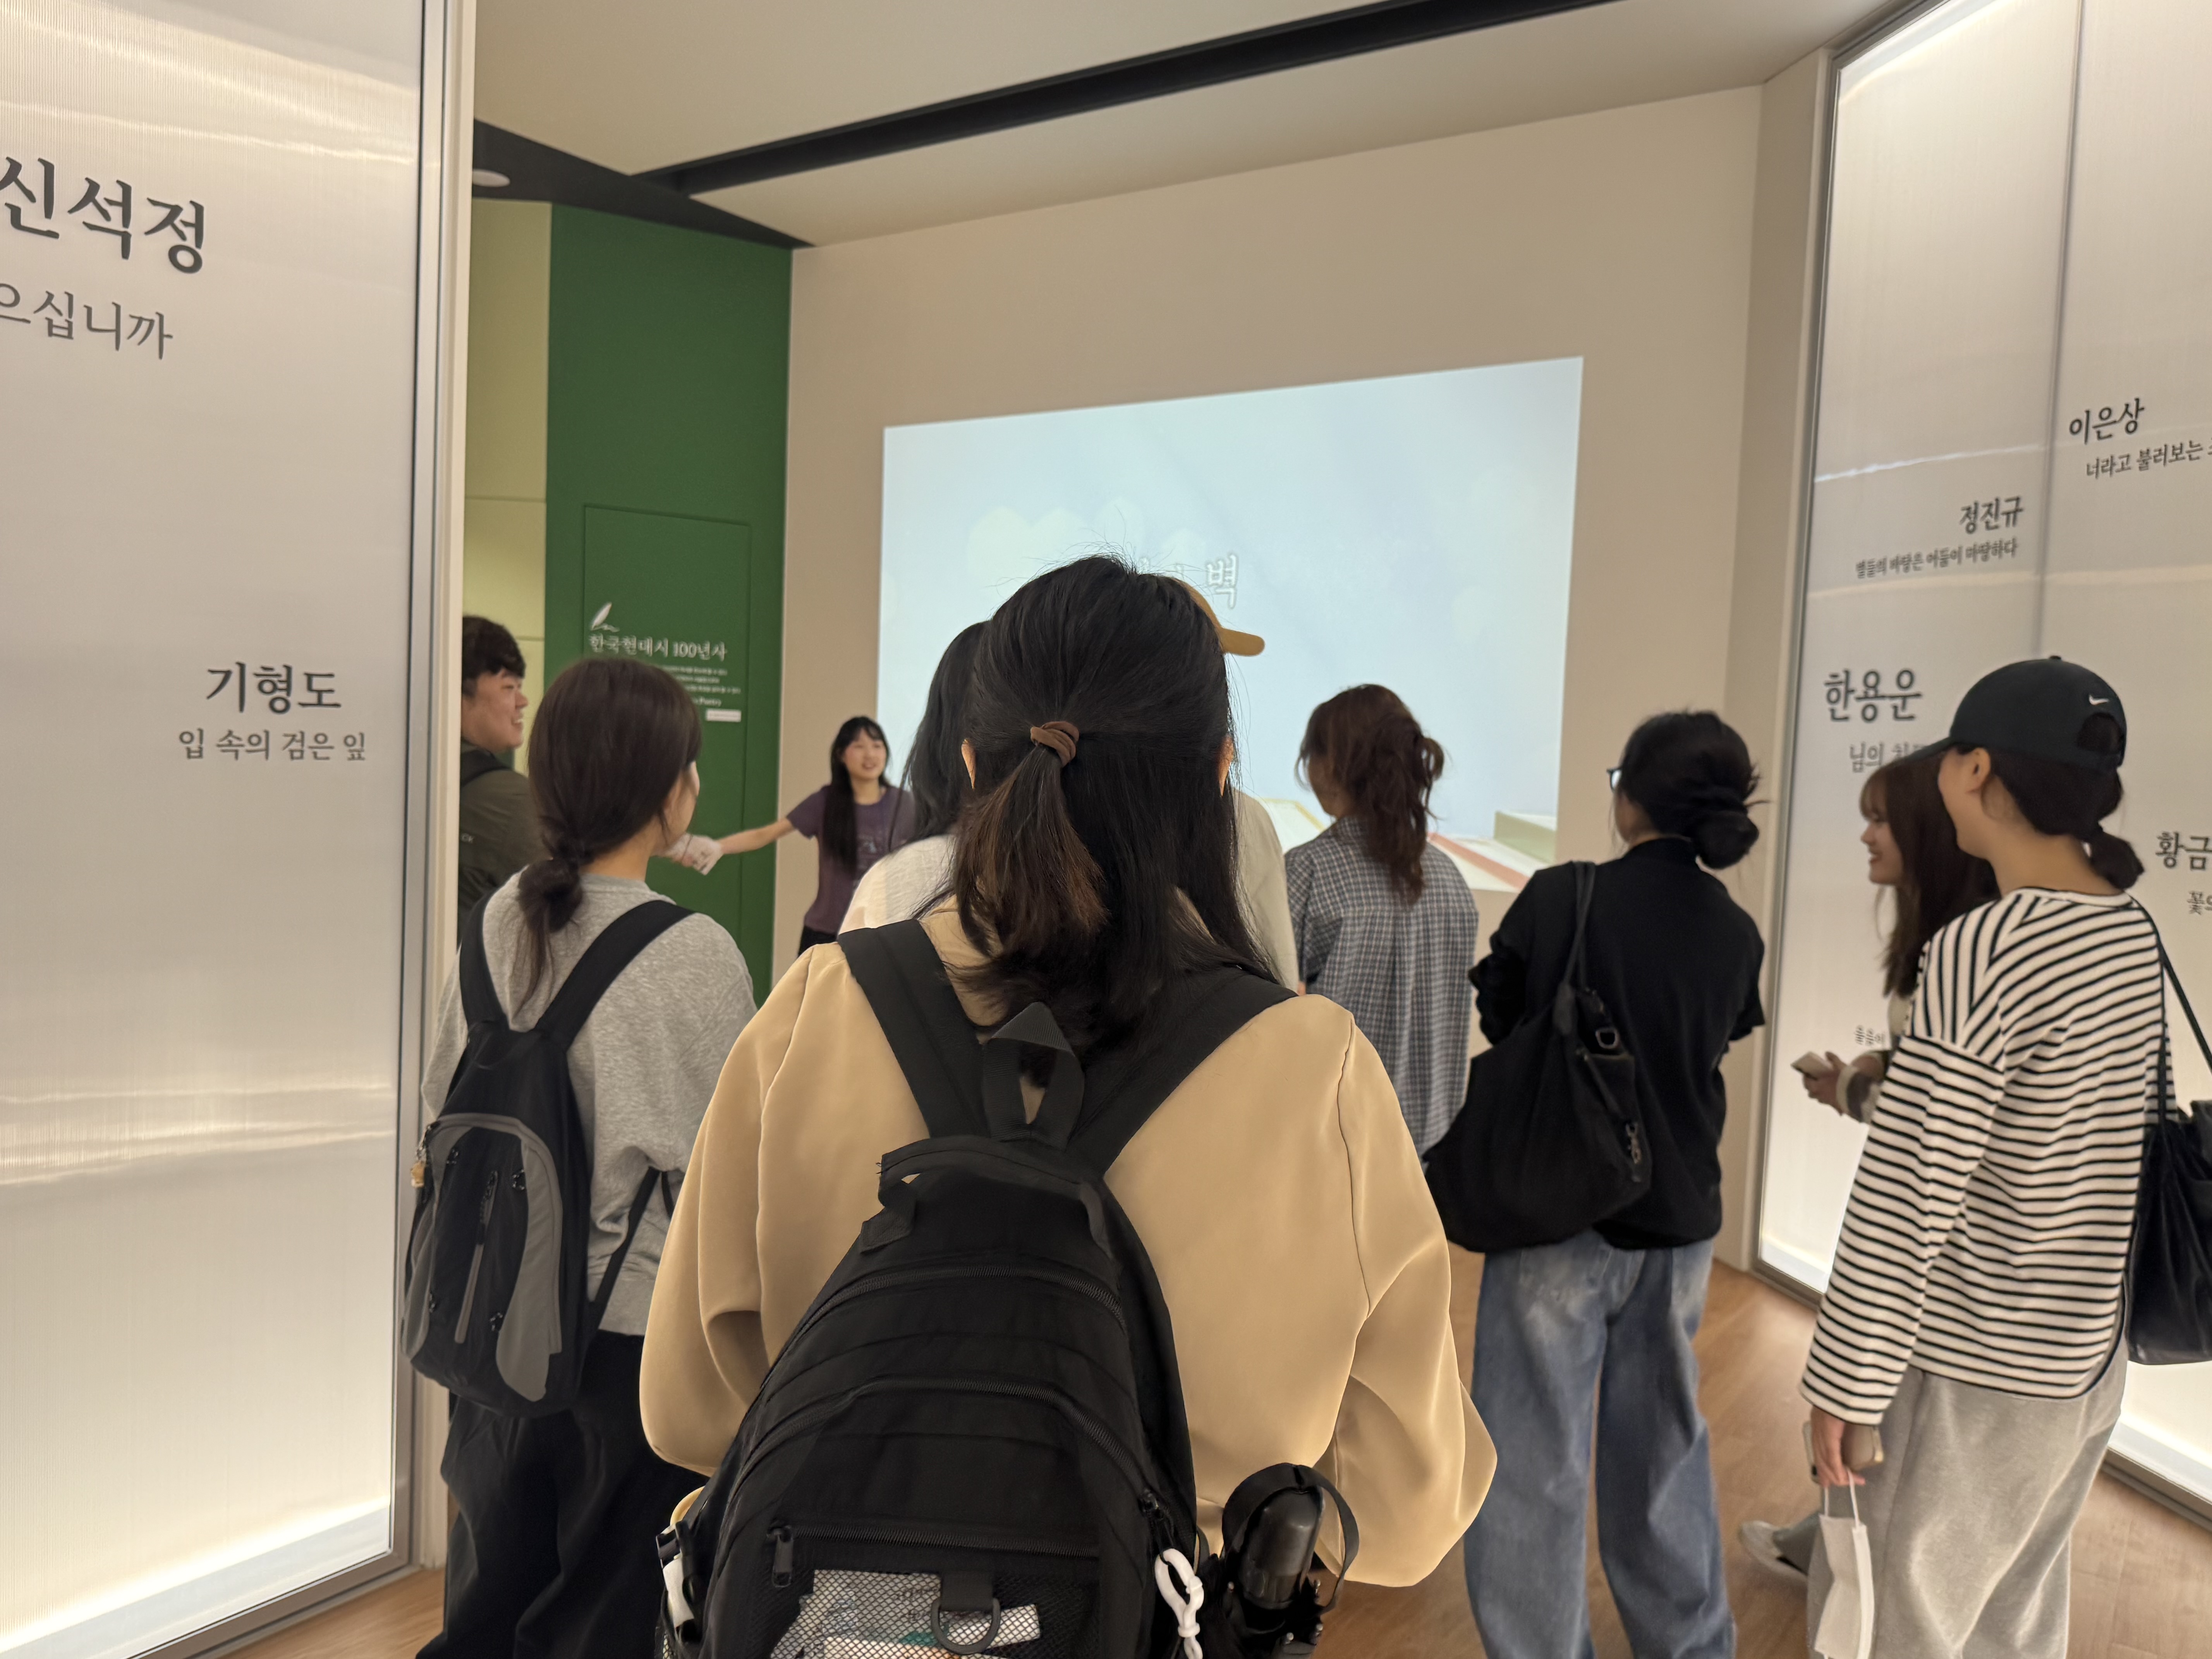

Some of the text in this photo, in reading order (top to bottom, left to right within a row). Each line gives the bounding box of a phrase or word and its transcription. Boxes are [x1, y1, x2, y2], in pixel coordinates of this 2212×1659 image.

[0, 156, 204, 274] 신석정
[0, 283, 173, 360] 으십니까
[2069, 397, 2145, 445] 이은상
[2086, 454, 2131, 479] 너라고
[2136, 440, 2203, 471] 불러보는
[1960, 495, 2024, 534] 정진규
[1966, 536, 2018, 563] 마땅하다
[1207, 553, 1238, 609] 벽
[589, 633, 728, 662] 한국현대시 100년사
[206, 661, 342, 714] 기형도
[1824, 668, 1923, 723] 한용운
[179, 728, 365, 761] 입 속의 검은 잎
[1850, 741, 1884, 773] 님의
